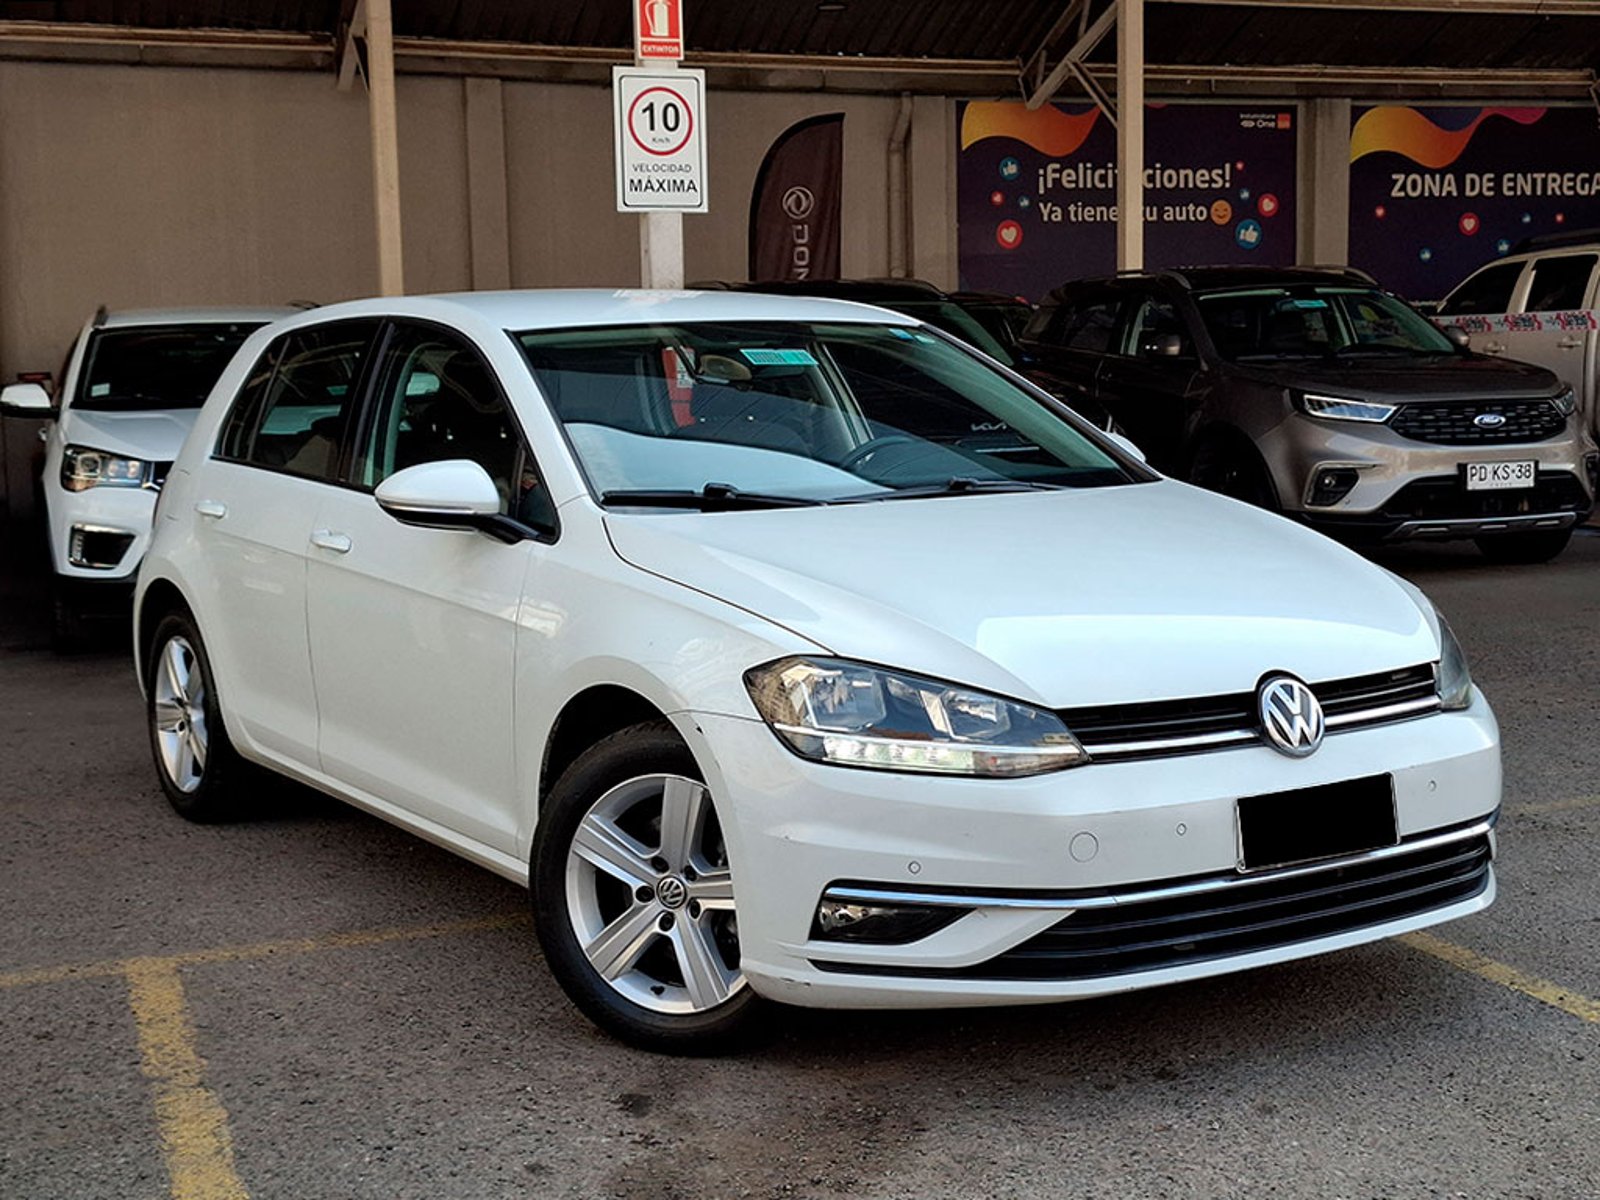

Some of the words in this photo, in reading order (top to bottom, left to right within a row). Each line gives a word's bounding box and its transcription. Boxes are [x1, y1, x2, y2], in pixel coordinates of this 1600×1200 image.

[641, 102, 680, 132] 10
[632, 163, 692, 173] VELOCIDAD
[1038, 163, 1231, 194] ¡Feliciciones!
[629, 174, 698, 193] MÁXIMA
[1390, 173, 1458, 198] ZONA
[1464, 172, 1496, 197] DE
[1038, 202, 1062, 222] Ya
[1163, 203, 1208, 222] auto
